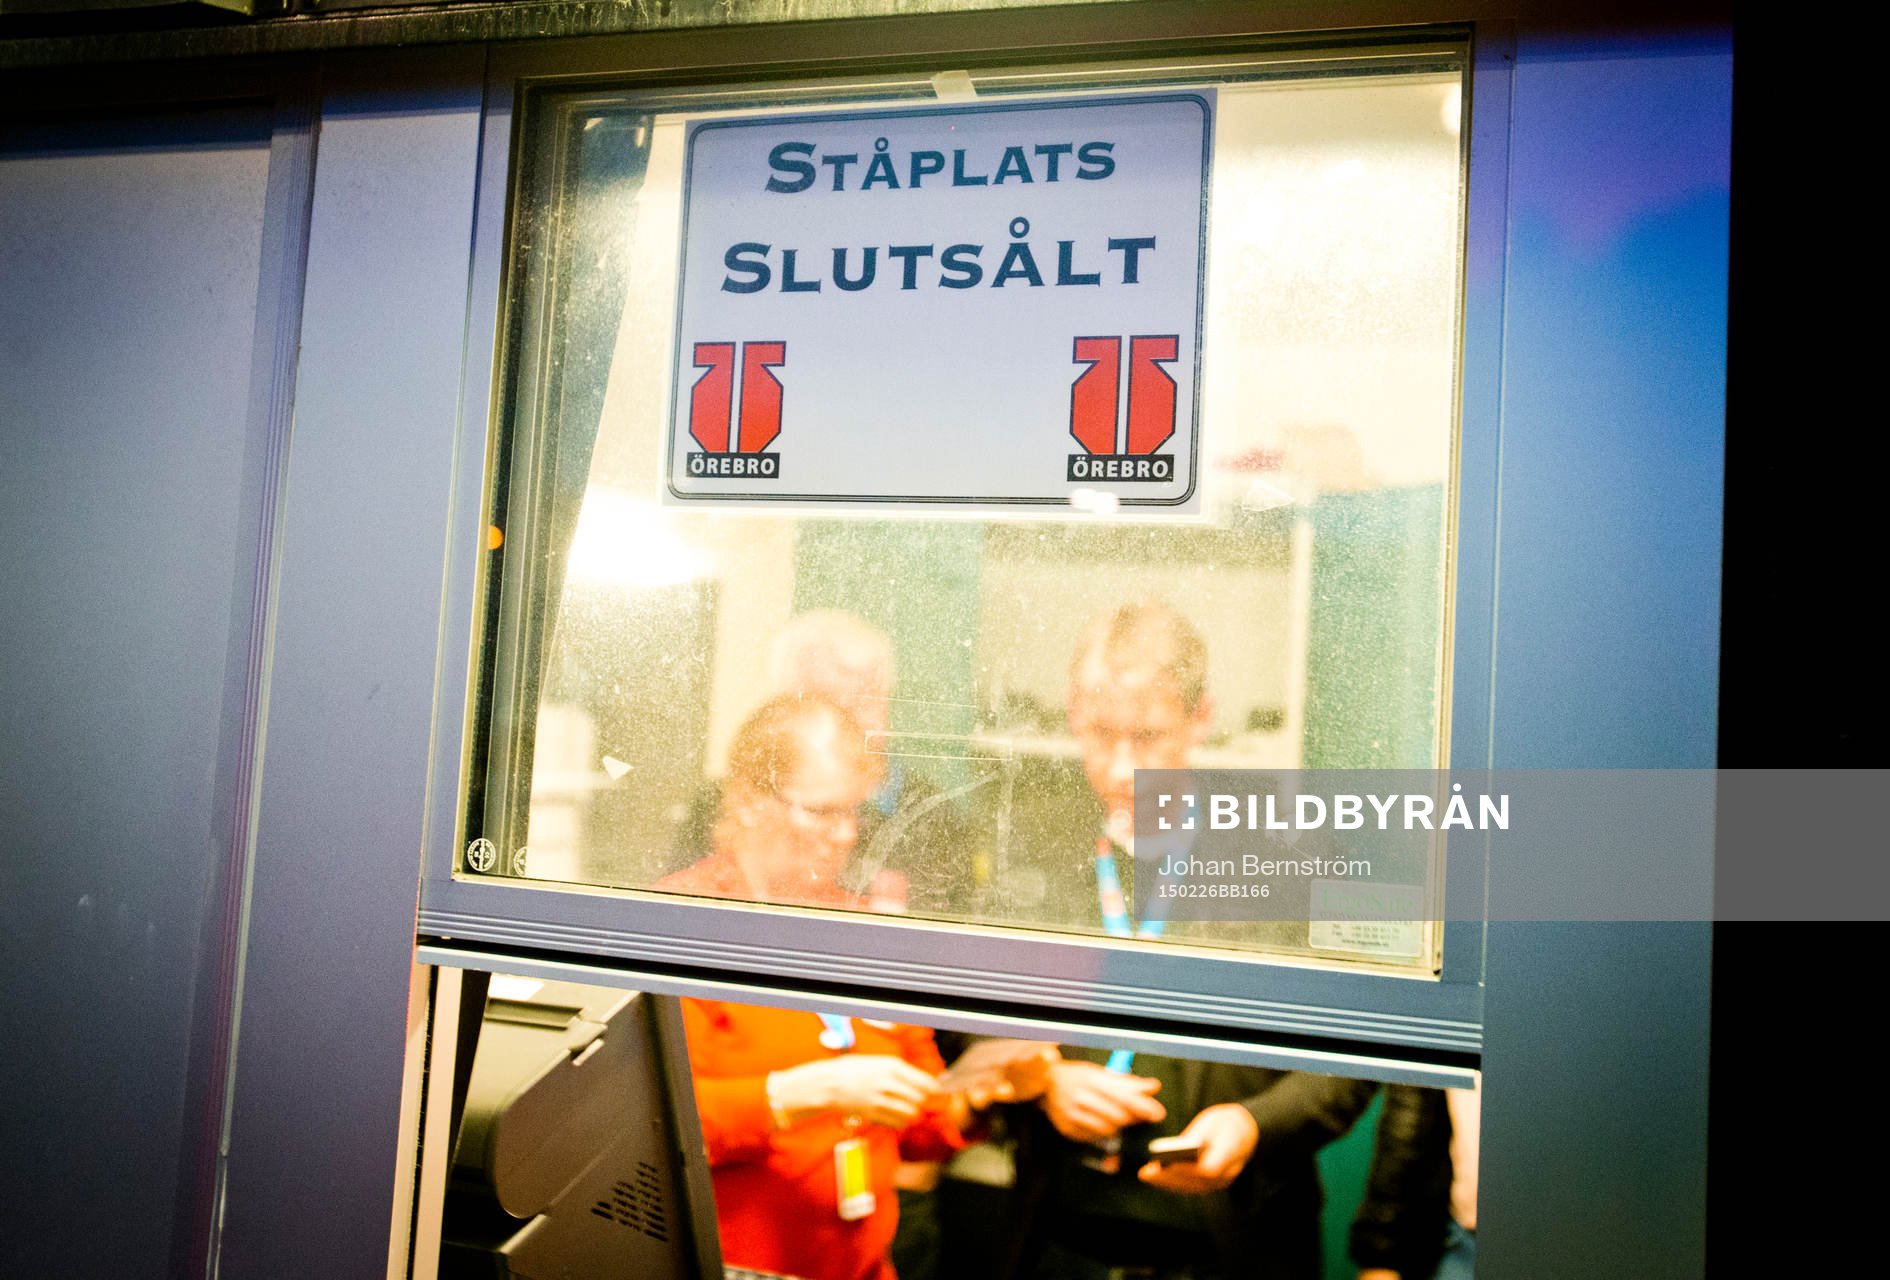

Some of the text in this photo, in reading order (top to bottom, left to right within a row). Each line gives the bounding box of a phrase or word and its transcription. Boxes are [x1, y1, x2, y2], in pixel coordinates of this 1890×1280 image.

[764, 137, 1116, 194] STÅPLATS
[720, 216, 1157, 294] SLUTSÅLT
[690, 455, 776, 475] ÖREBRO
[1072, 456, 1169, 479] ÖREBRO
